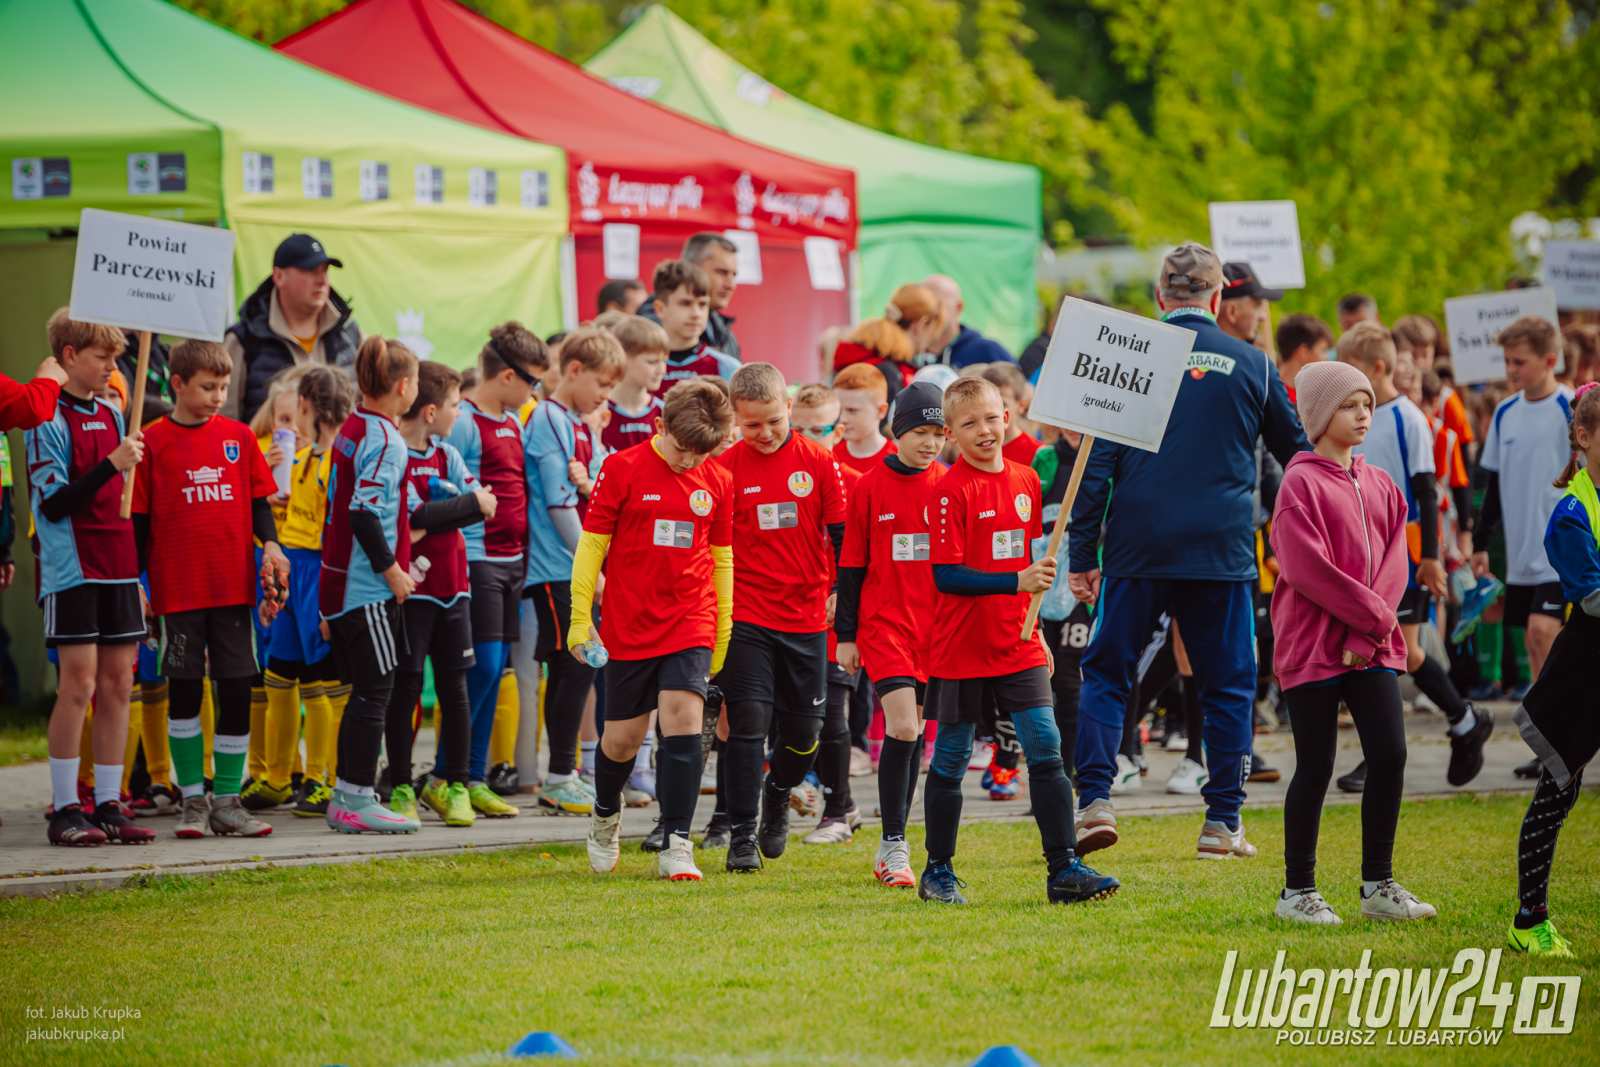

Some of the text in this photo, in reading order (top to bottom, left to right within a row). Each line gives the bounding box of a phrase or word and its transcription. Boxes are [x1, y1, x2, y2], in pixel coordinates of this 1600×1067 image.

[128, 231, 187, 254] Powiat
[92, 253, 216, 289] Parczewski
[1096, 325, 1151, 354] Powiat
[1072, 352, 1154, 395] Bialski
[1081, 393, 1126, 413] /grodzki/
[182, 483, 234, 503] TINE
[878, 513, 895, 521] JAKO
[979, 509, 996, 519] JAKO
[1061, 622, 1089, 648] 18
